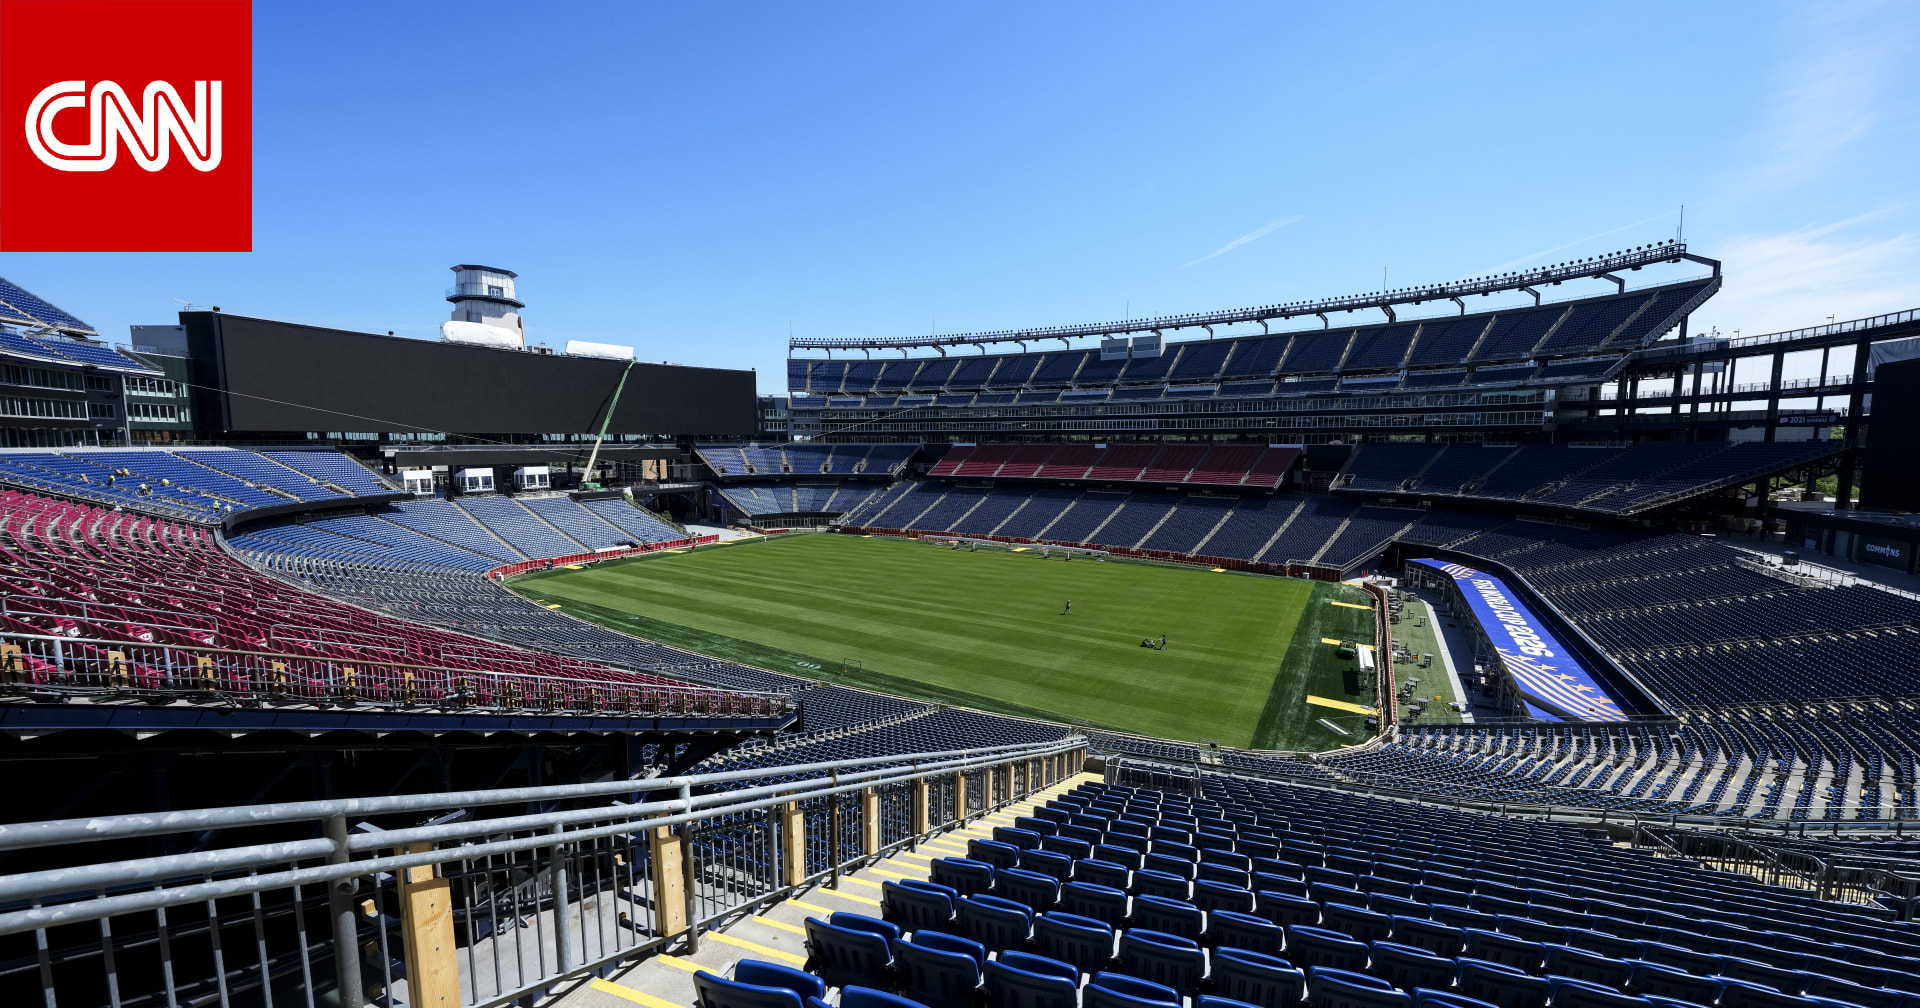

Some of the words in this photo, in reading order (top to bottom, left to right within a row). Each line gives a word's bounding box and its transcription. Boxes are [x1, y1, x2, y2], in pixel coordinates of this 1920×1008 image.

[1478, 590, 1515, 611] WORLD
[1493, 610, 1528, 626] CUP
[1503, 623, 1555, 658] 2026
